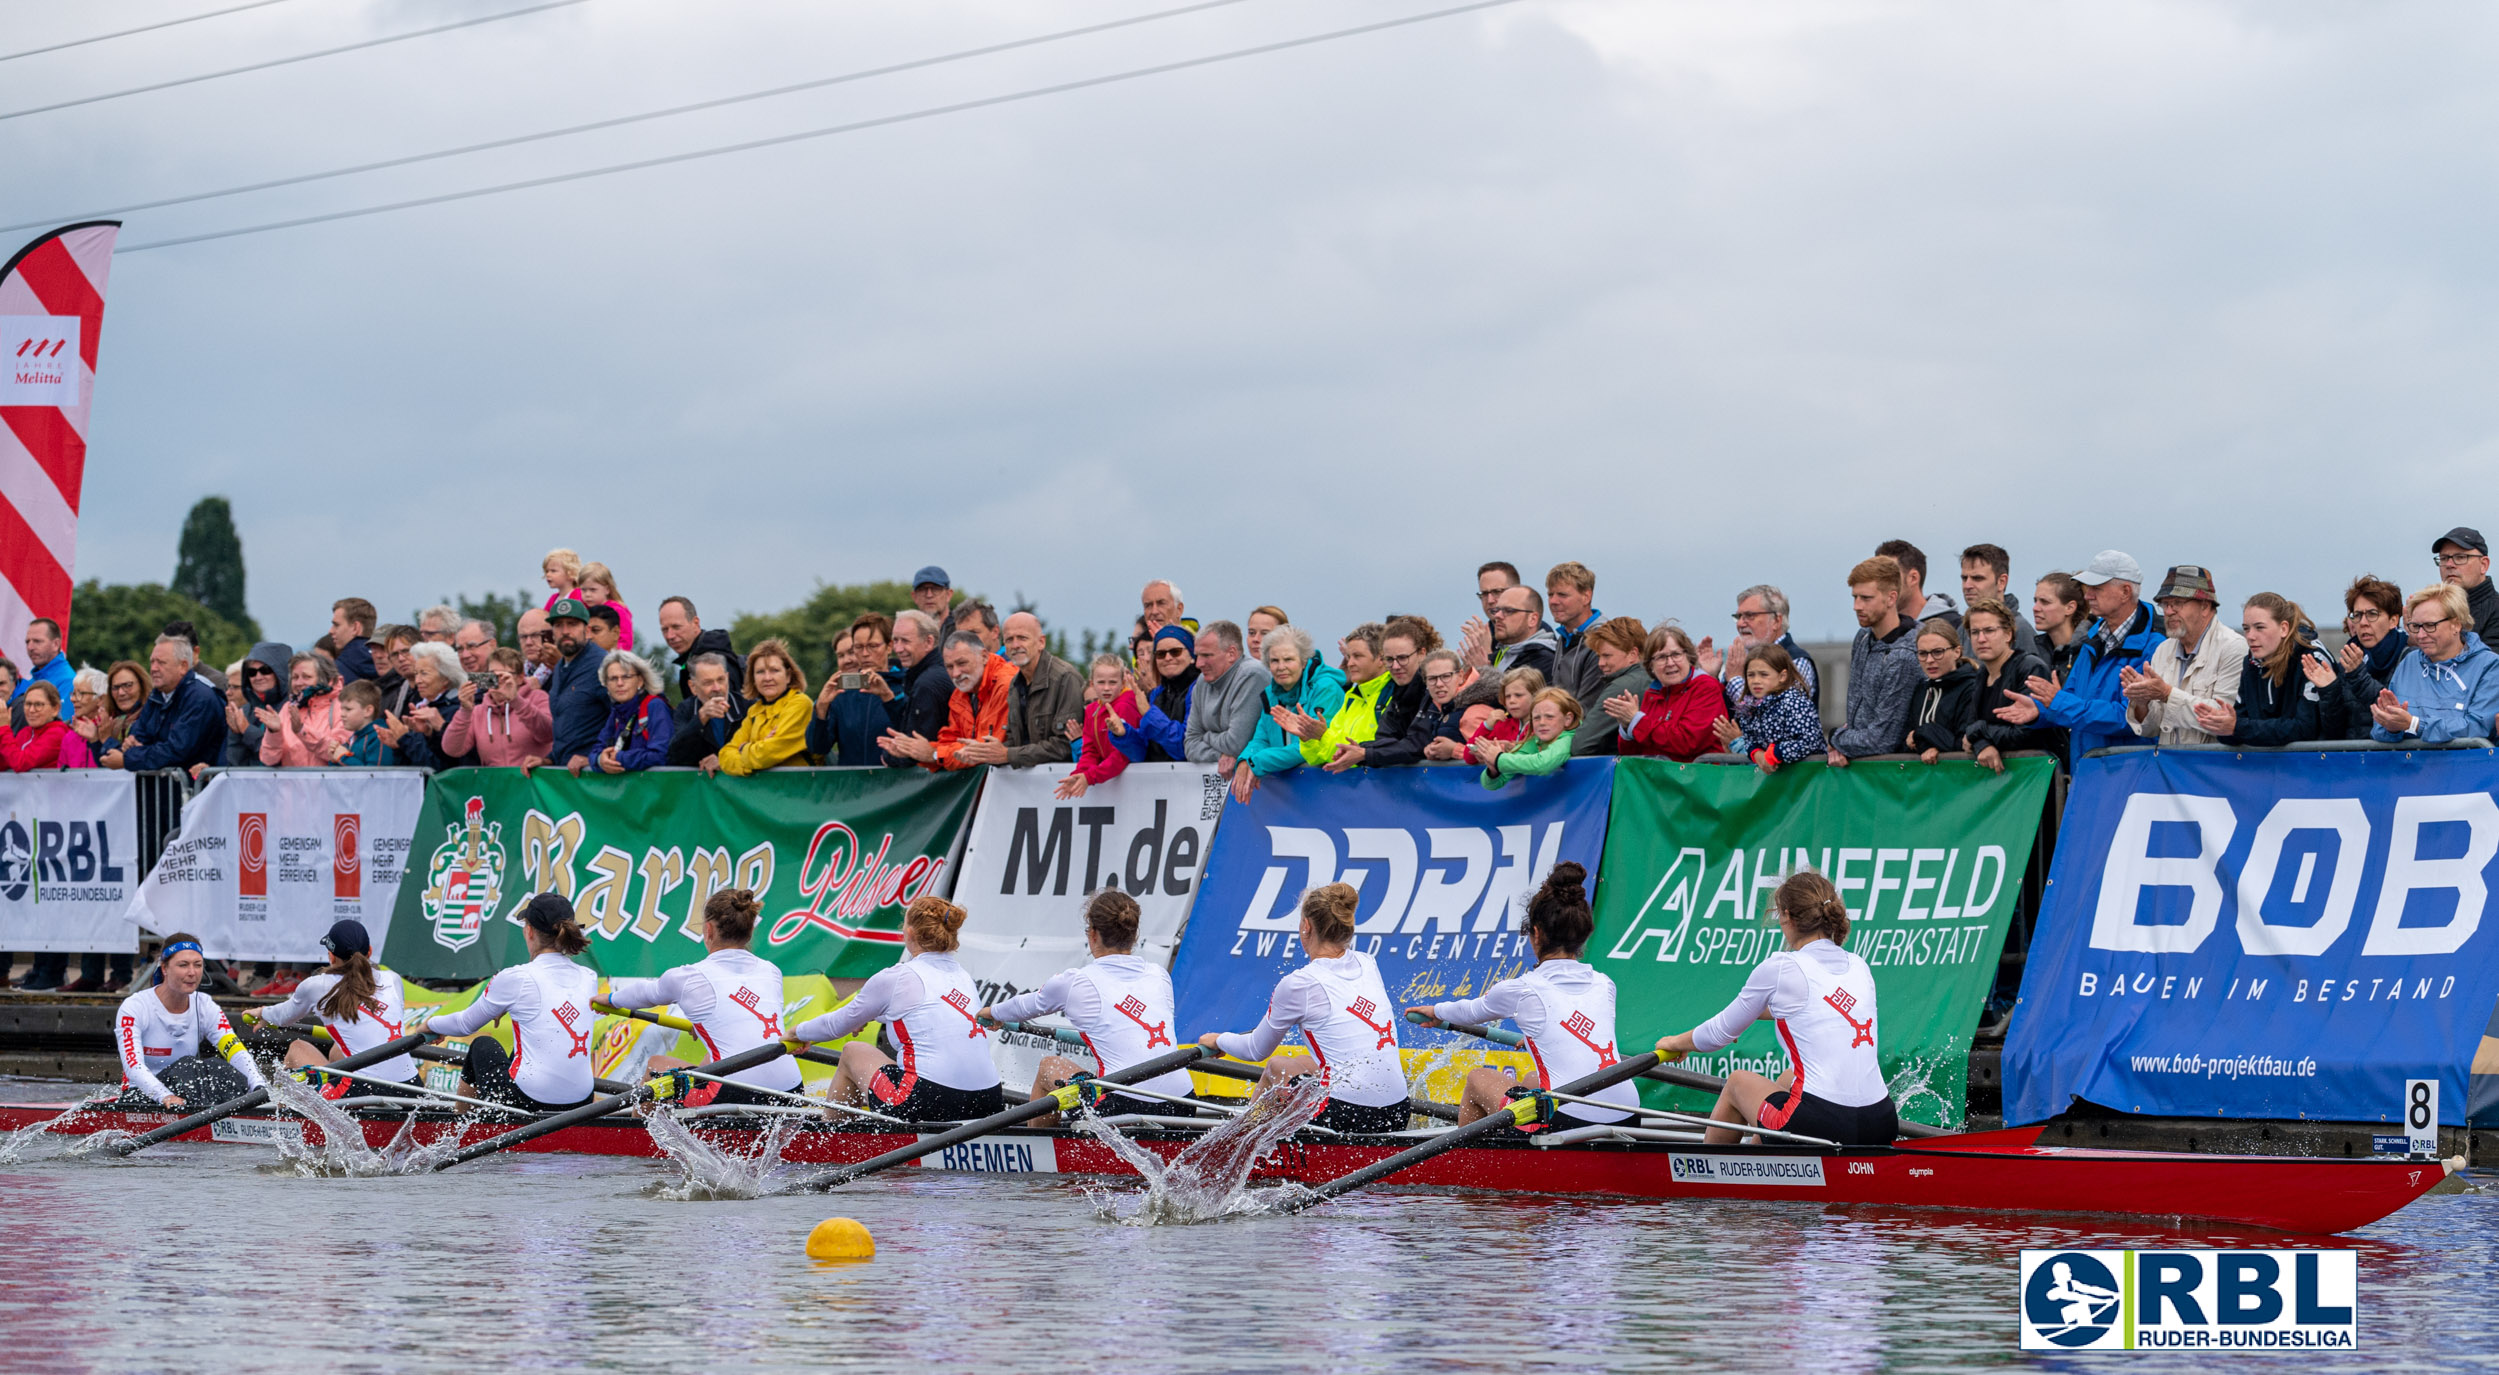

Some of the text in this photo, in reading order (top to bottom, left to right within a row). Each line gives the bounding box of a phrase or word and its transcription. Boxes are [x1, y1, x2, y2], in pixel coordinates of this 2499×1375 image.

[14, 371, 62, 385] Melitta
[37, 820, 124, 883] RBL
[279, 837, 322, 851] GEMEINSAM
[373, 838, 412, 852] GEMEINSA
[1000, 798, 1199, 898] MT.de
[159, 854, 198, 871] MEHR
[279, 853, 300, 867] MEHR
[372, 854, 395, 868] MEHR
[2089, 791, 2499, 956] BOB
[39, 887, 124, 902] RUDER-BUNDESLIGA
[2079, 972, 2455, 1002] BAUEN IM BESTAND
[2131, 1053, 2317, 1081] www.bob-projektbau.de
[2409, 1081, 2431, 1130] 8
[220, 1121, 239, 1135] RBL
[2420, 1139, 2436, 1149] RBL
[943, 1142, 1034, 1173] BREMEN
[1686, 1158, 1714, 1174] RBL
[1719, 1161, 1821, 1178] RUDER-BUNDESLIGA
[1847, 1161, 1875, 1175] JOHN
[1908, 1167, 1934, 1178] olympia
